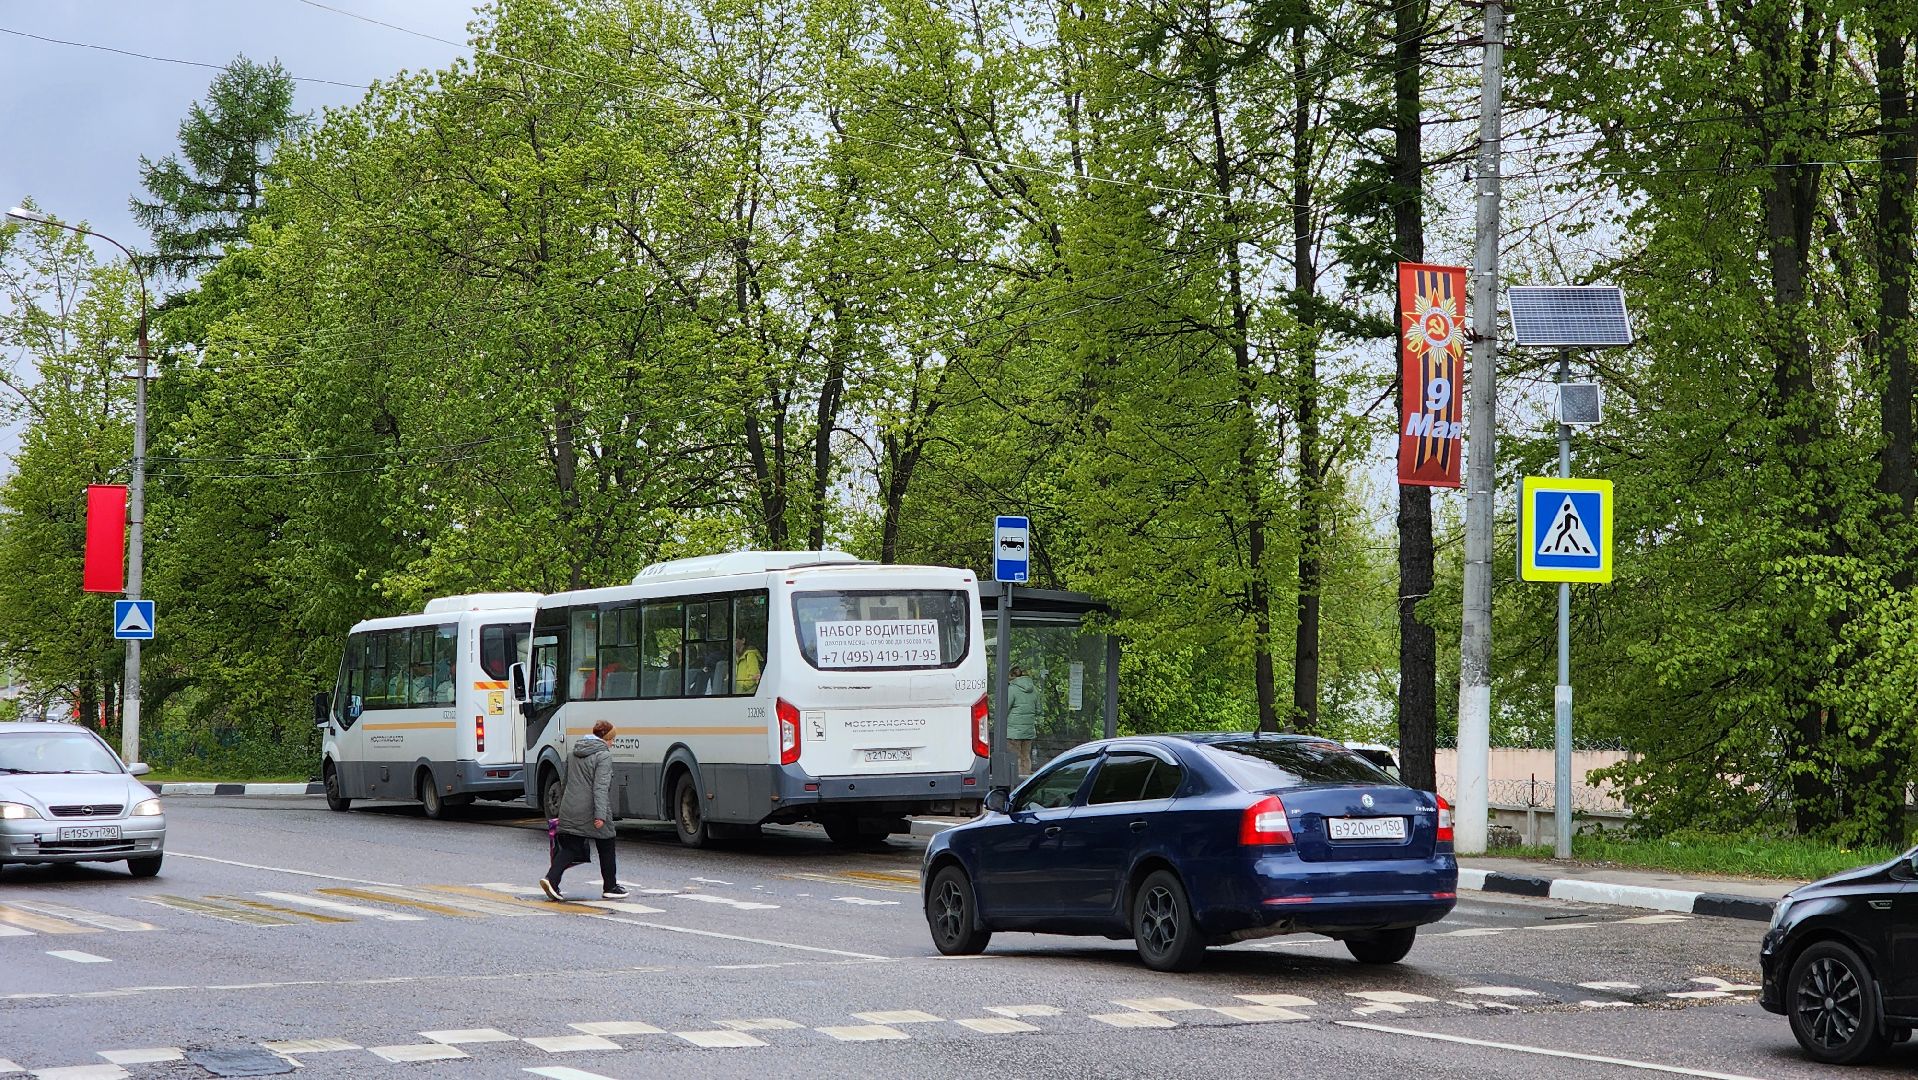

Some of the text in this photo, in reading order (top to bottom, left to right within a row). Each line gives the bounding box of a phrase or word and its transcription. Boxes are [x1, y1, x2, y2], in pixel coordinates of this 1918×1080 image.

[1425, 377, 1451, 410] 9
[1405, 412, 1462, 439] Мая
[819, 621, 936, 637] НАБОР ВОДИТЕЛЕЙ
[821, 649, 937, 664] +7 (495) 419-17-95
[844, 719, 926, 728] МОСТРАНСАВТО
[64, 827, 116, 838] Е195УТ 790
[1335, 820, 1400, 836] В920МР 150
